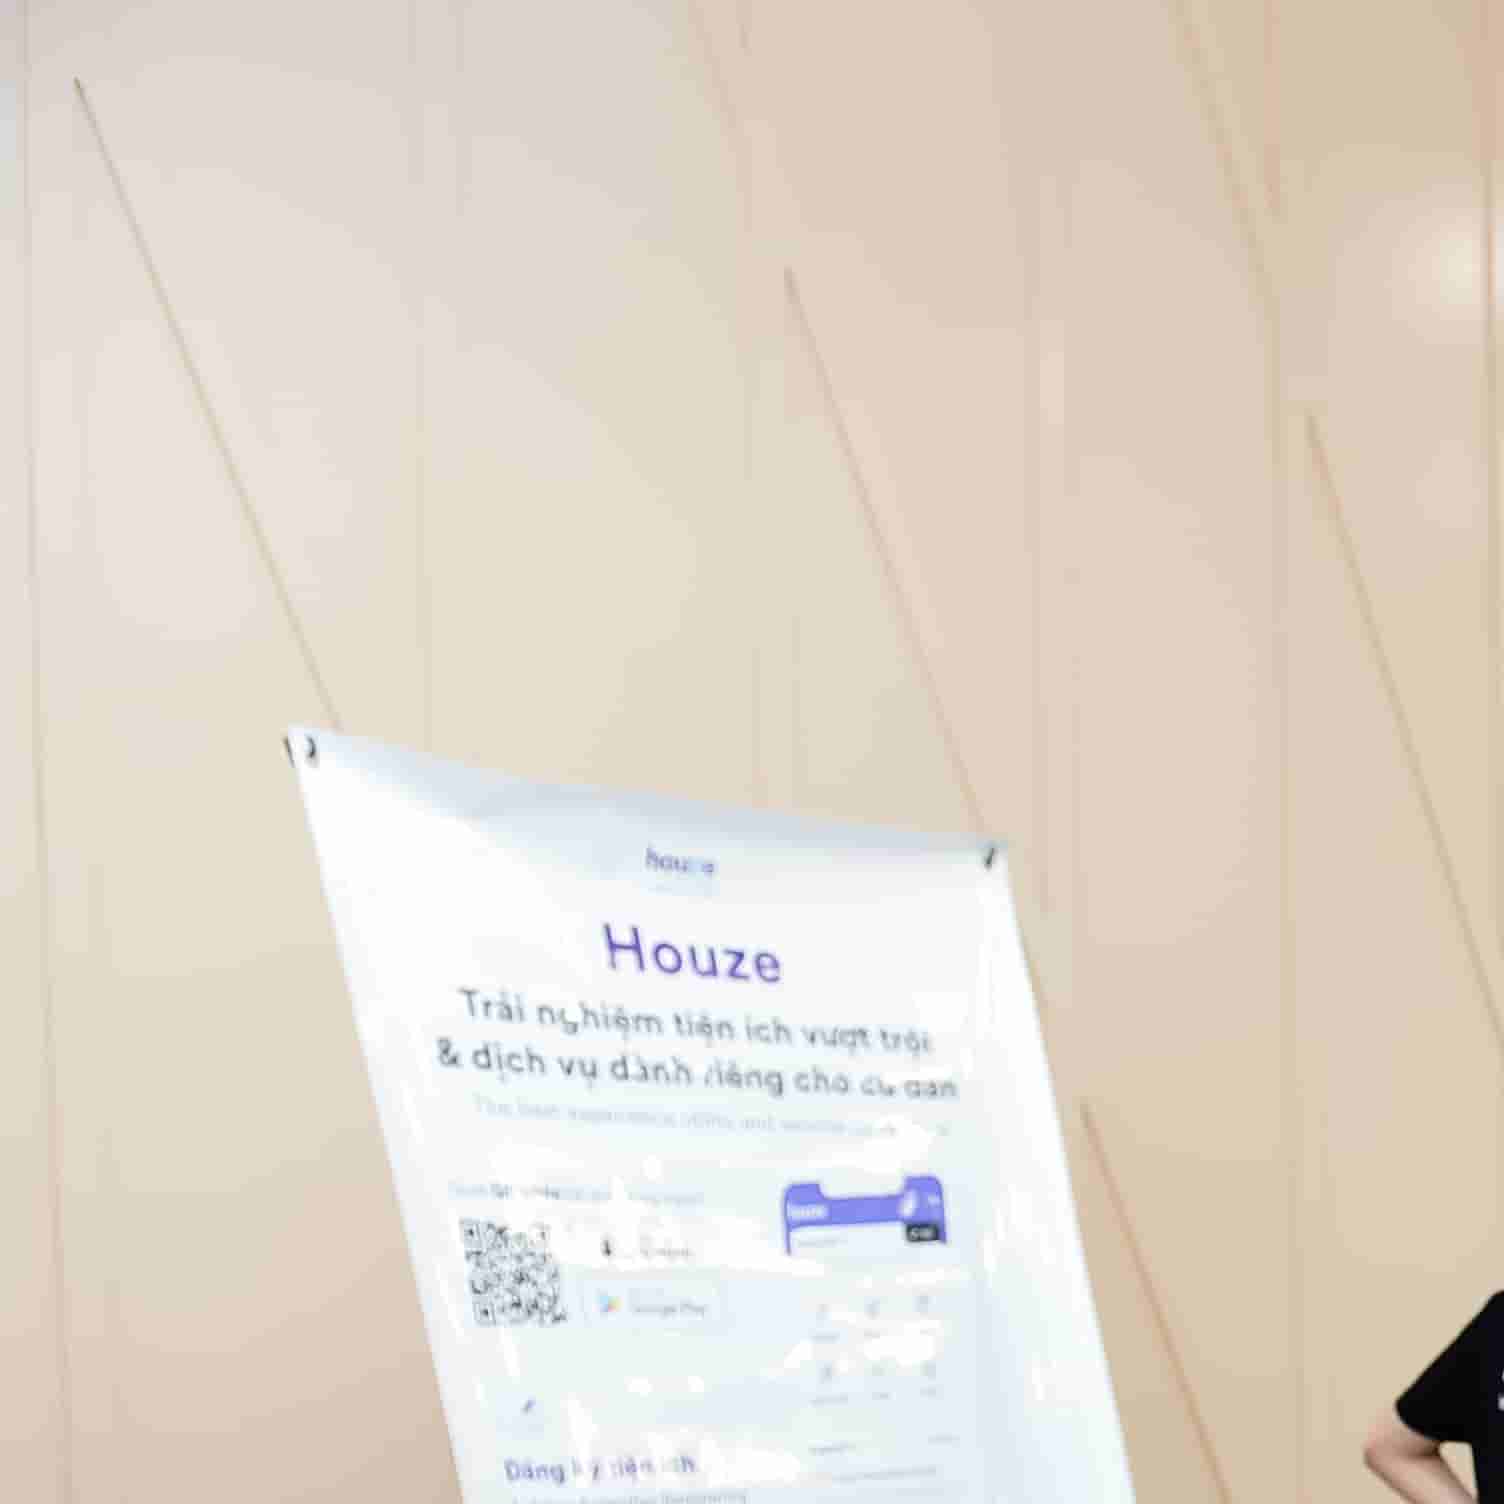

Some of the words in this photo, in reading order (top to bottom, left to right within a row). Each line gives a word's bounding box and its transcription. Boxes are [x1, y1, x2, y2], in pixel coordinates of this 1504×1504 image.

[646, 845, 715, 877] houe
[603, 922, 783, 983] Houze
[436, 1036, 463, 1069] &
[793, 1065, 850, 1096] cho
